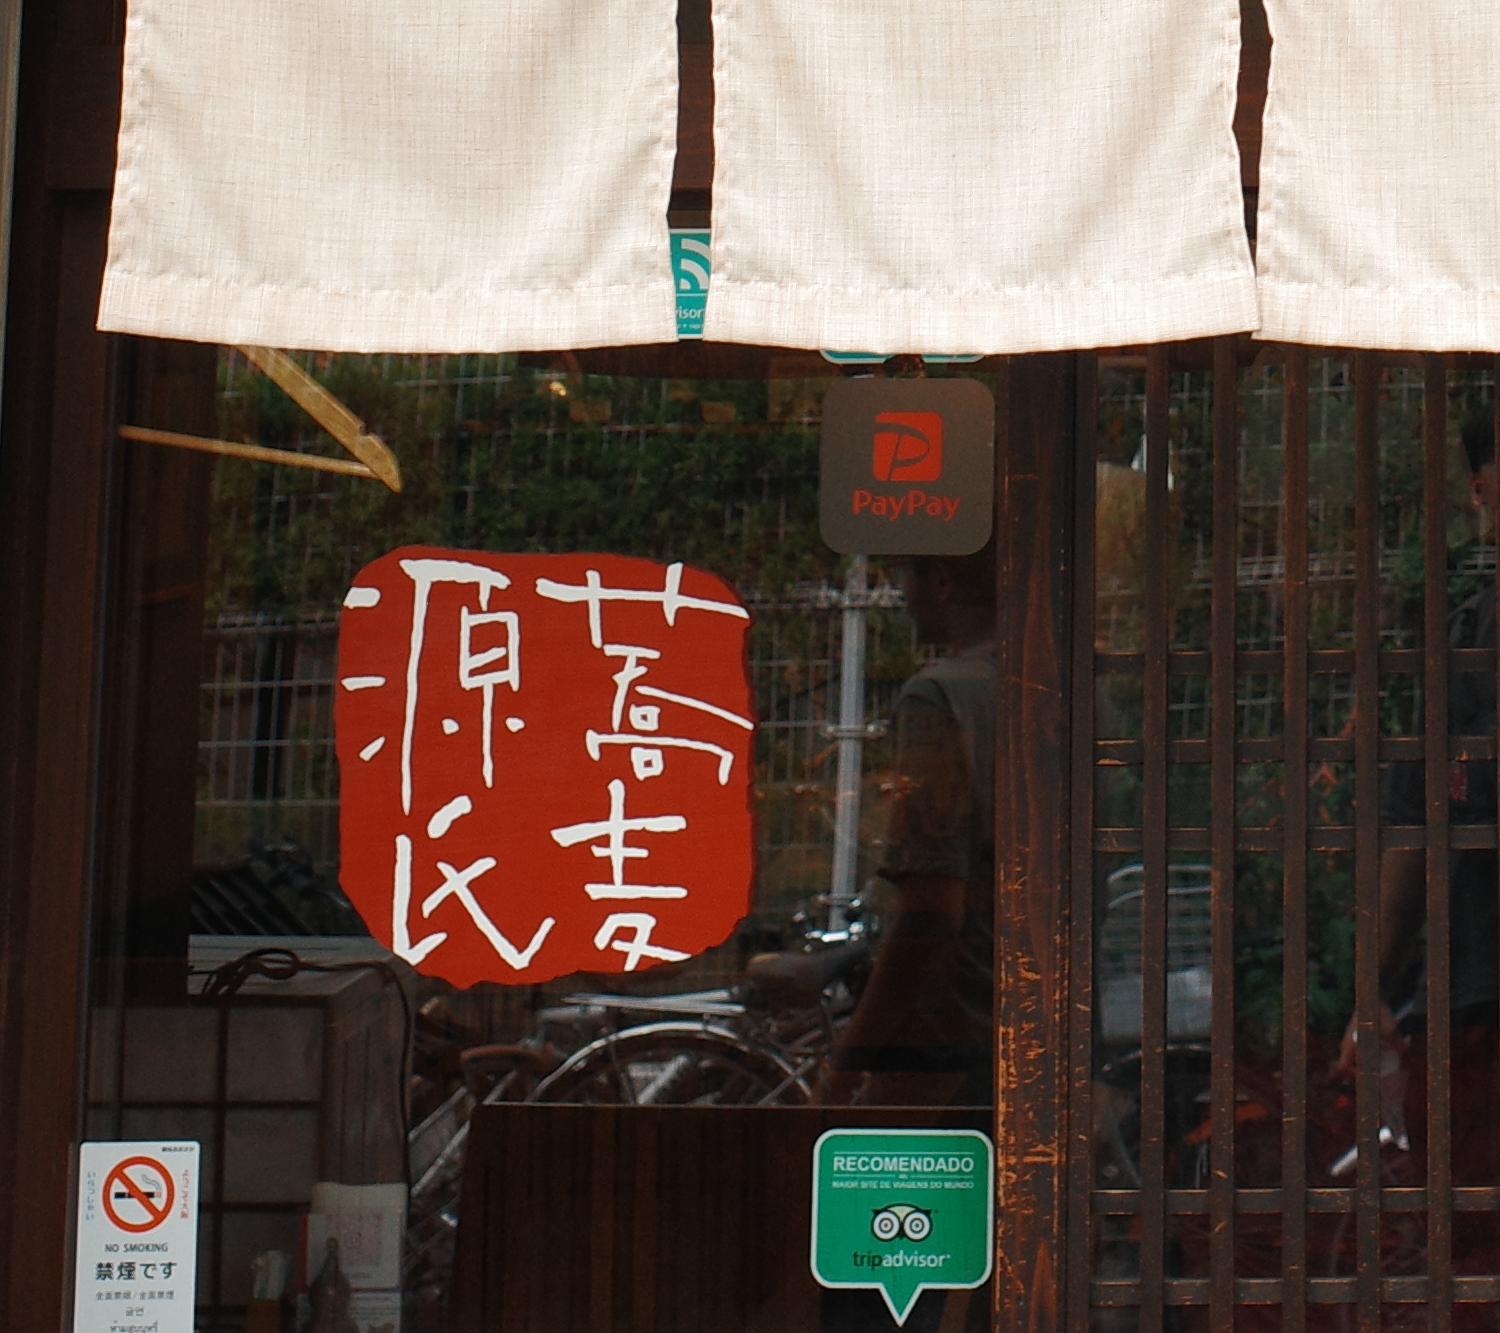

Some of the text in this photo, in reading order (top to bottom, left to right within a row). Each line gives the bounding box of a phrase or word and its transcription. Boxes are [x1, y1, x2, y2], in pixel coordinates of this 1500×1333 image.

[852, 489, 961, 521] PayPay
[833, 1156, 974, 1173] RECOMENDADO
[104, 1243, 169, 1252] NO SMOKING
[852, 1250, 946, 1270] tripadvisor
[95, 1261, 178, 1281] 禁煙です
